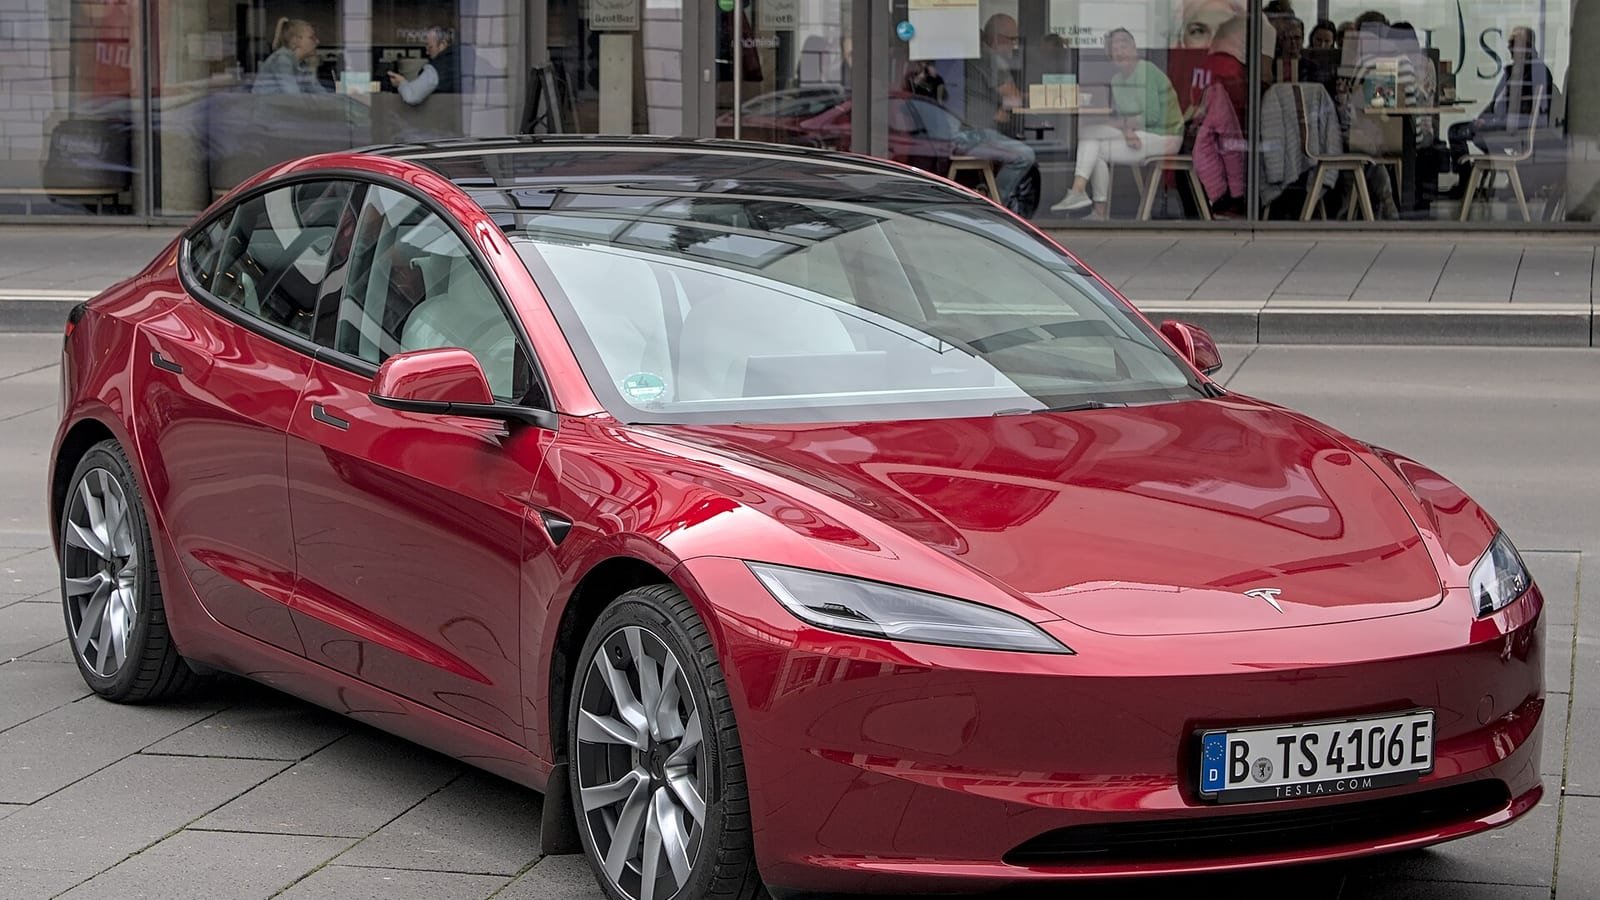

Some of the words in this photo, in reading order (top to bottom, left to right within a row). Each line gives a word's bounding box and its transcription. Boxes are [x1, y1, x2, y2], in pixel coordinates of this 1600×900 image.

[1228, 740, 1250, 784] B
[1277, 733, 1319, 779] TS
[1209, 769, 1217, 781] D
[1275, 778, 1373, 797] TESLA.COM
